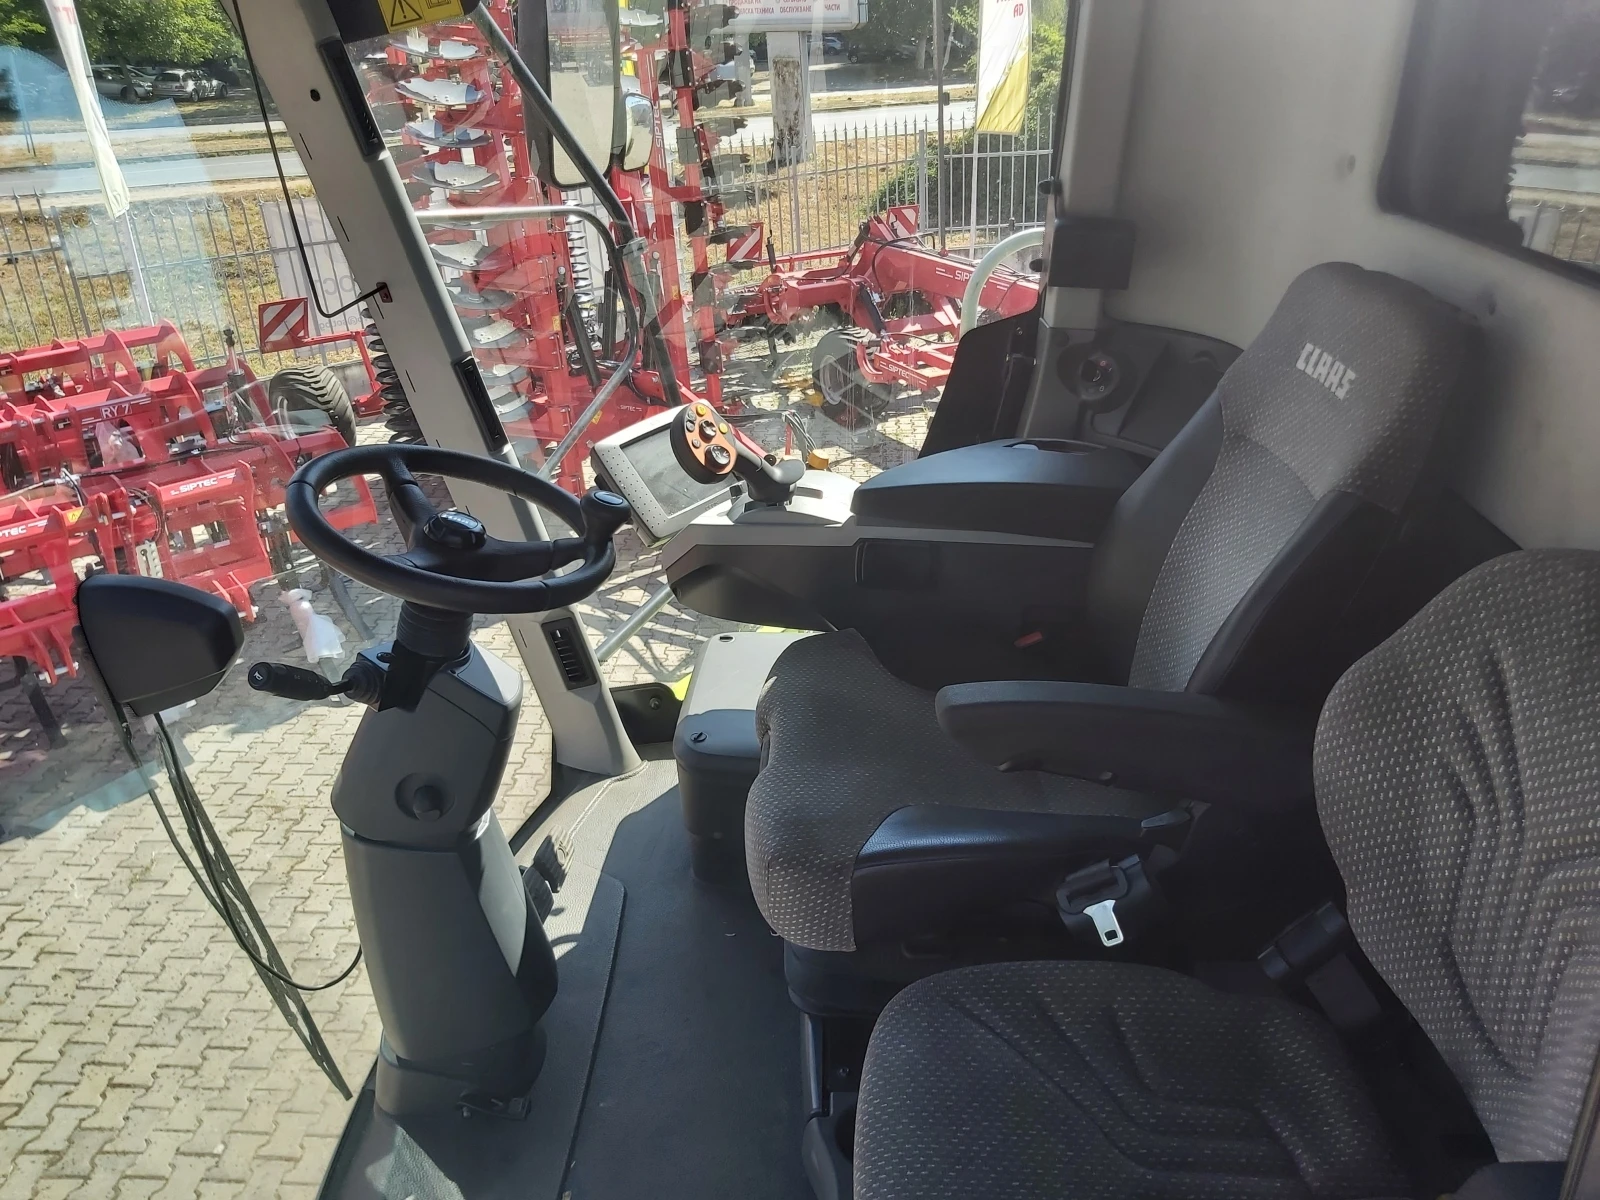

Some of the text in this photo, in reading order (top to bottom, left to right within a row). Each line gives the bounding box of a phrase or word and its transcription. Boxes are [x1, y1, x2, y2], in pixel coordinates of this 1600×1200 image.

[824, 3, 841, 11] ЧАСТИ
[653, 100, 664, 148] SIPTEC
[888, 364, 911, 379] SIPTEC
[1295, 342, 1356, 401] CLAAS
[101, 403, 130, 419] RY 7
[179, 477, 219, 494] SIPTEC
